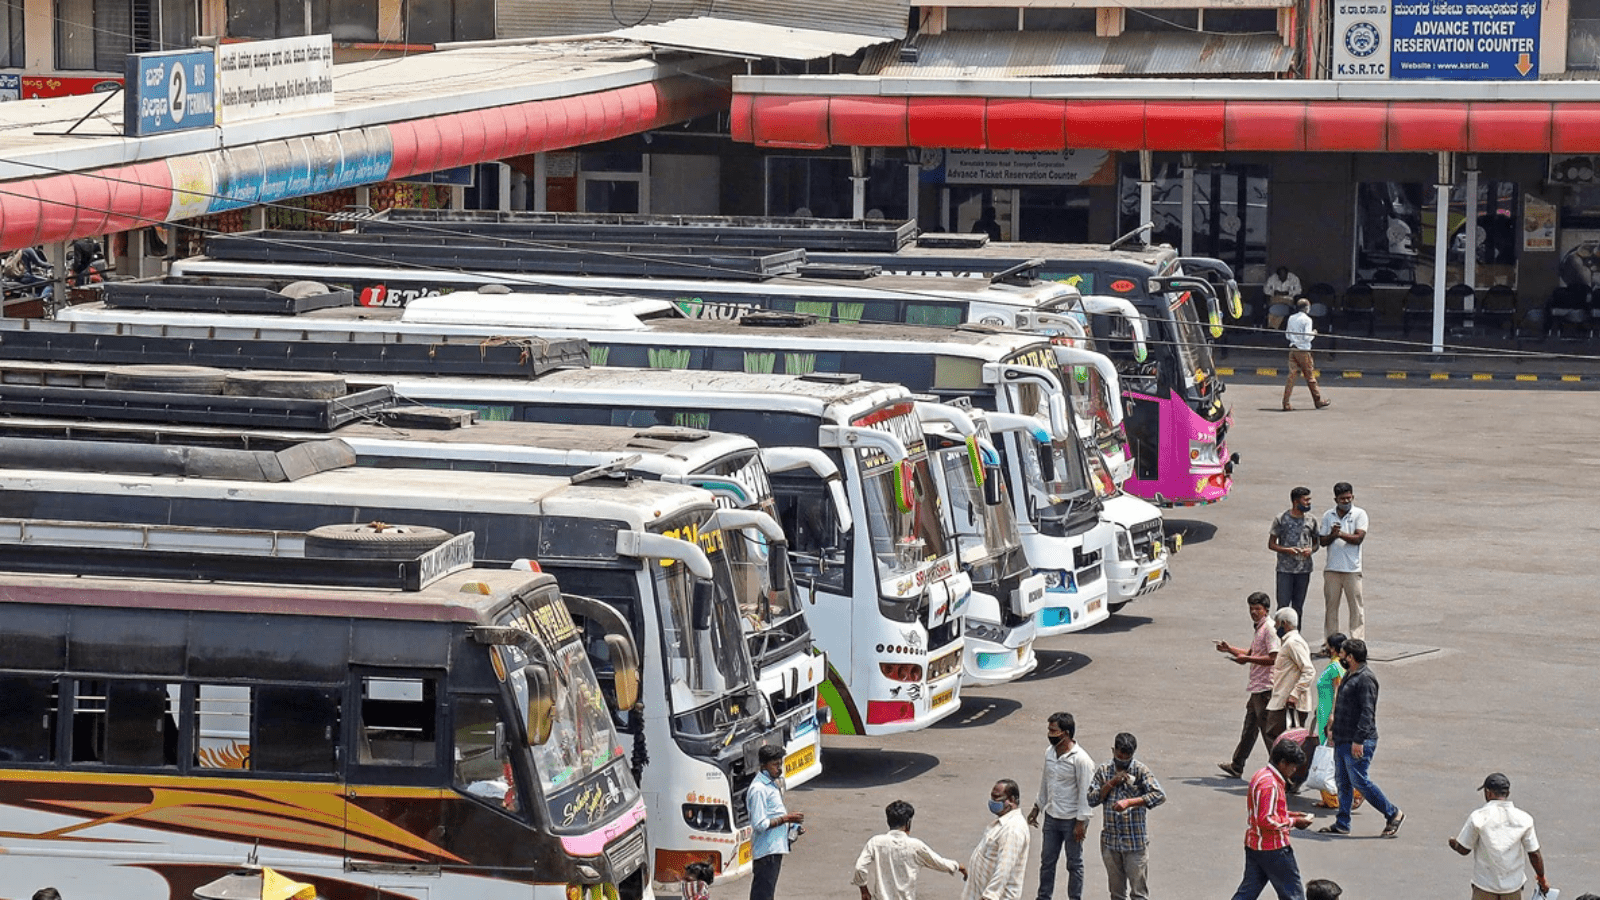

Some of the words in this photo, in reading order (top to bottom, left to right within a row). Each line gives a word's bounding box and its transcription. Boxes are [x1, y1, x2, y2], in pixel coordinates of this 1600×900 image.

[1394, 3, 1430, 16] ಮುಂಗಡ
[1414, 21, 1469, 35] ADVANCE
[1473, 21, 1515, 35] TICKET
[1394, 38, 1475, 52] RESERVATION
[1477, 38, 1534, 52] COUNTER
[1338, 64, 1385, 75] K.S.R.T.C
[1401, 62, 1431, 70] Website
[1437, 62, 1489, 70] www.ksrtc.in
[146, 62, 165, 86] ಬಸ್
[194, 64, 205, 86] BUS
[173, 71, 182, 111] 2
[187, 92, 213, 115] TERMINAL
[948, 169, 978, 179] Advance
[980, 169, 1003, 179] Ticket
[1004, 169, 1047, 180] Reservation
[1048, 170, 1077, 180] Counter
